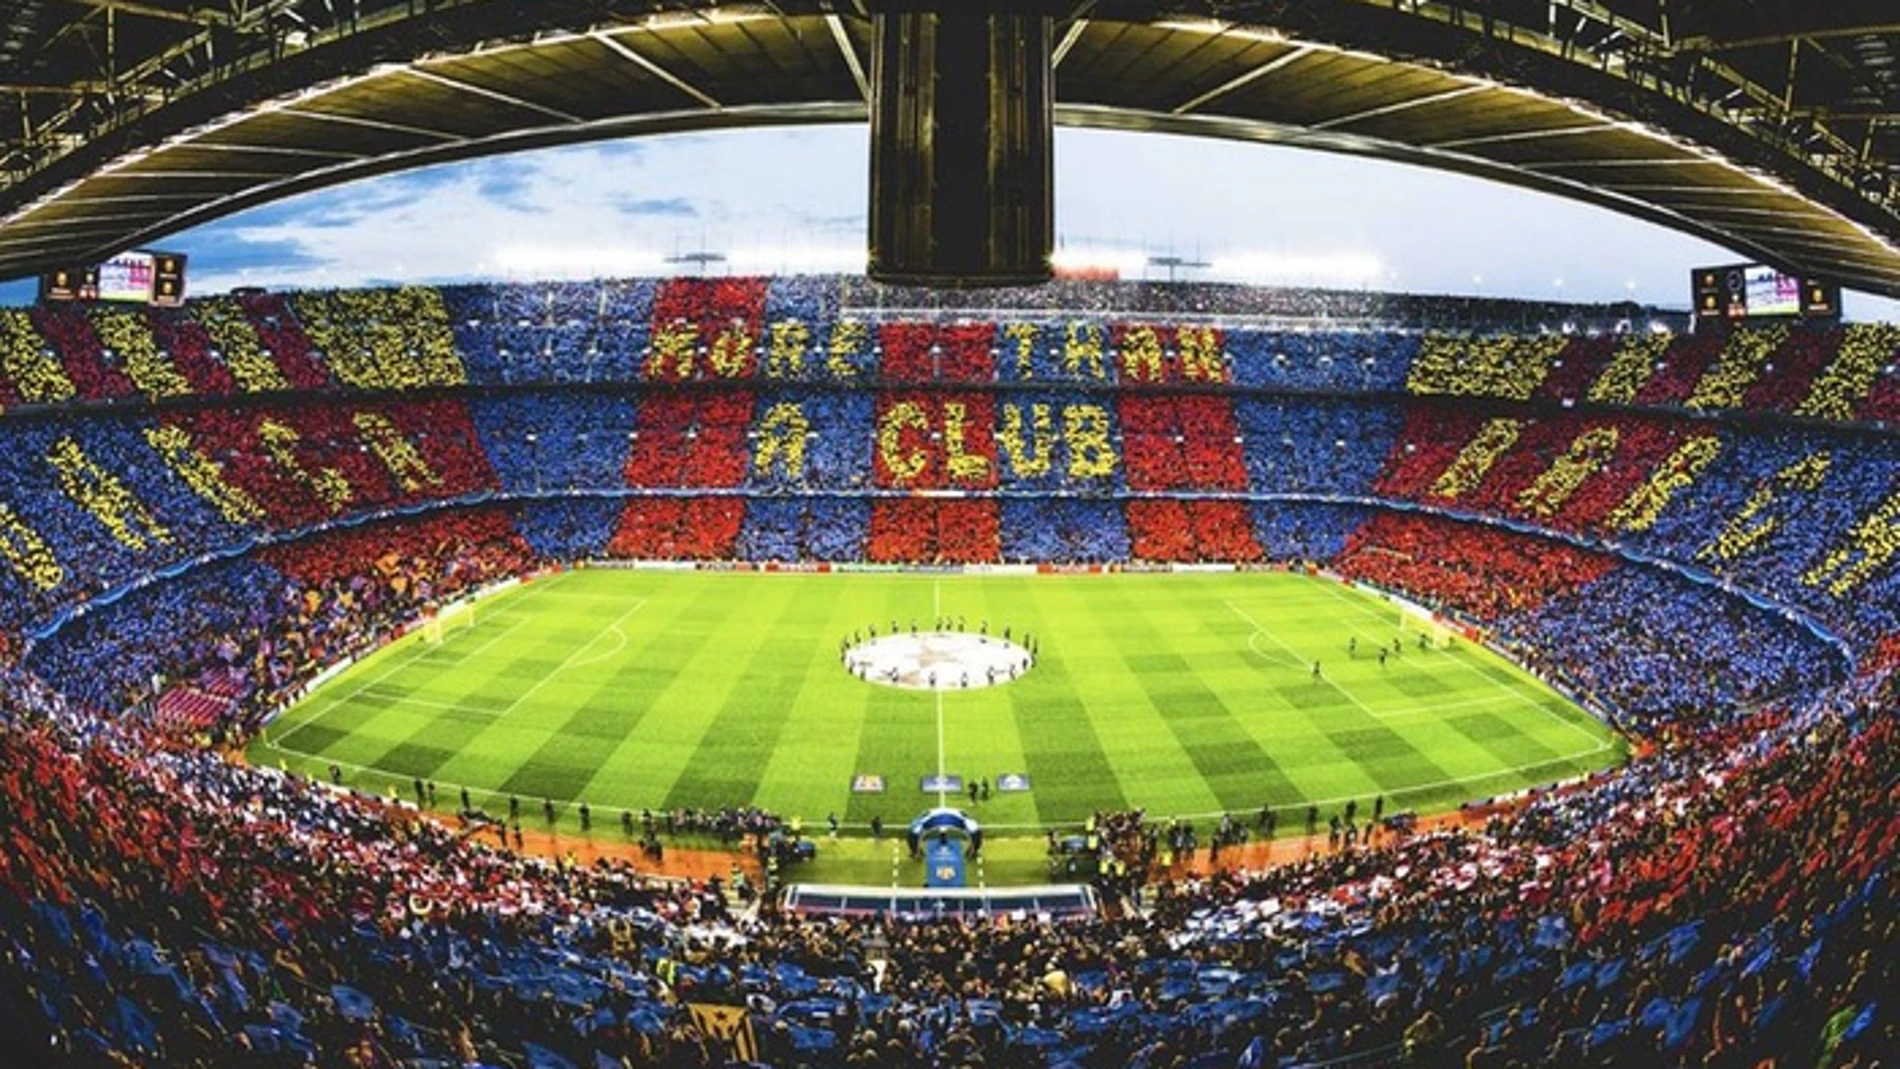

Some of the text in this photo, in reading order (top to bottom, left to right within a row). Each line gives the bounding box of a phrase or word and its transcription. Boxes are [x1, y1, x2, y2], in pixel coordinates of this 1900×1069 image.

[649, 322, 1224, 383] MORE THAN
[754, 402, 1119, 478] A CLUB
